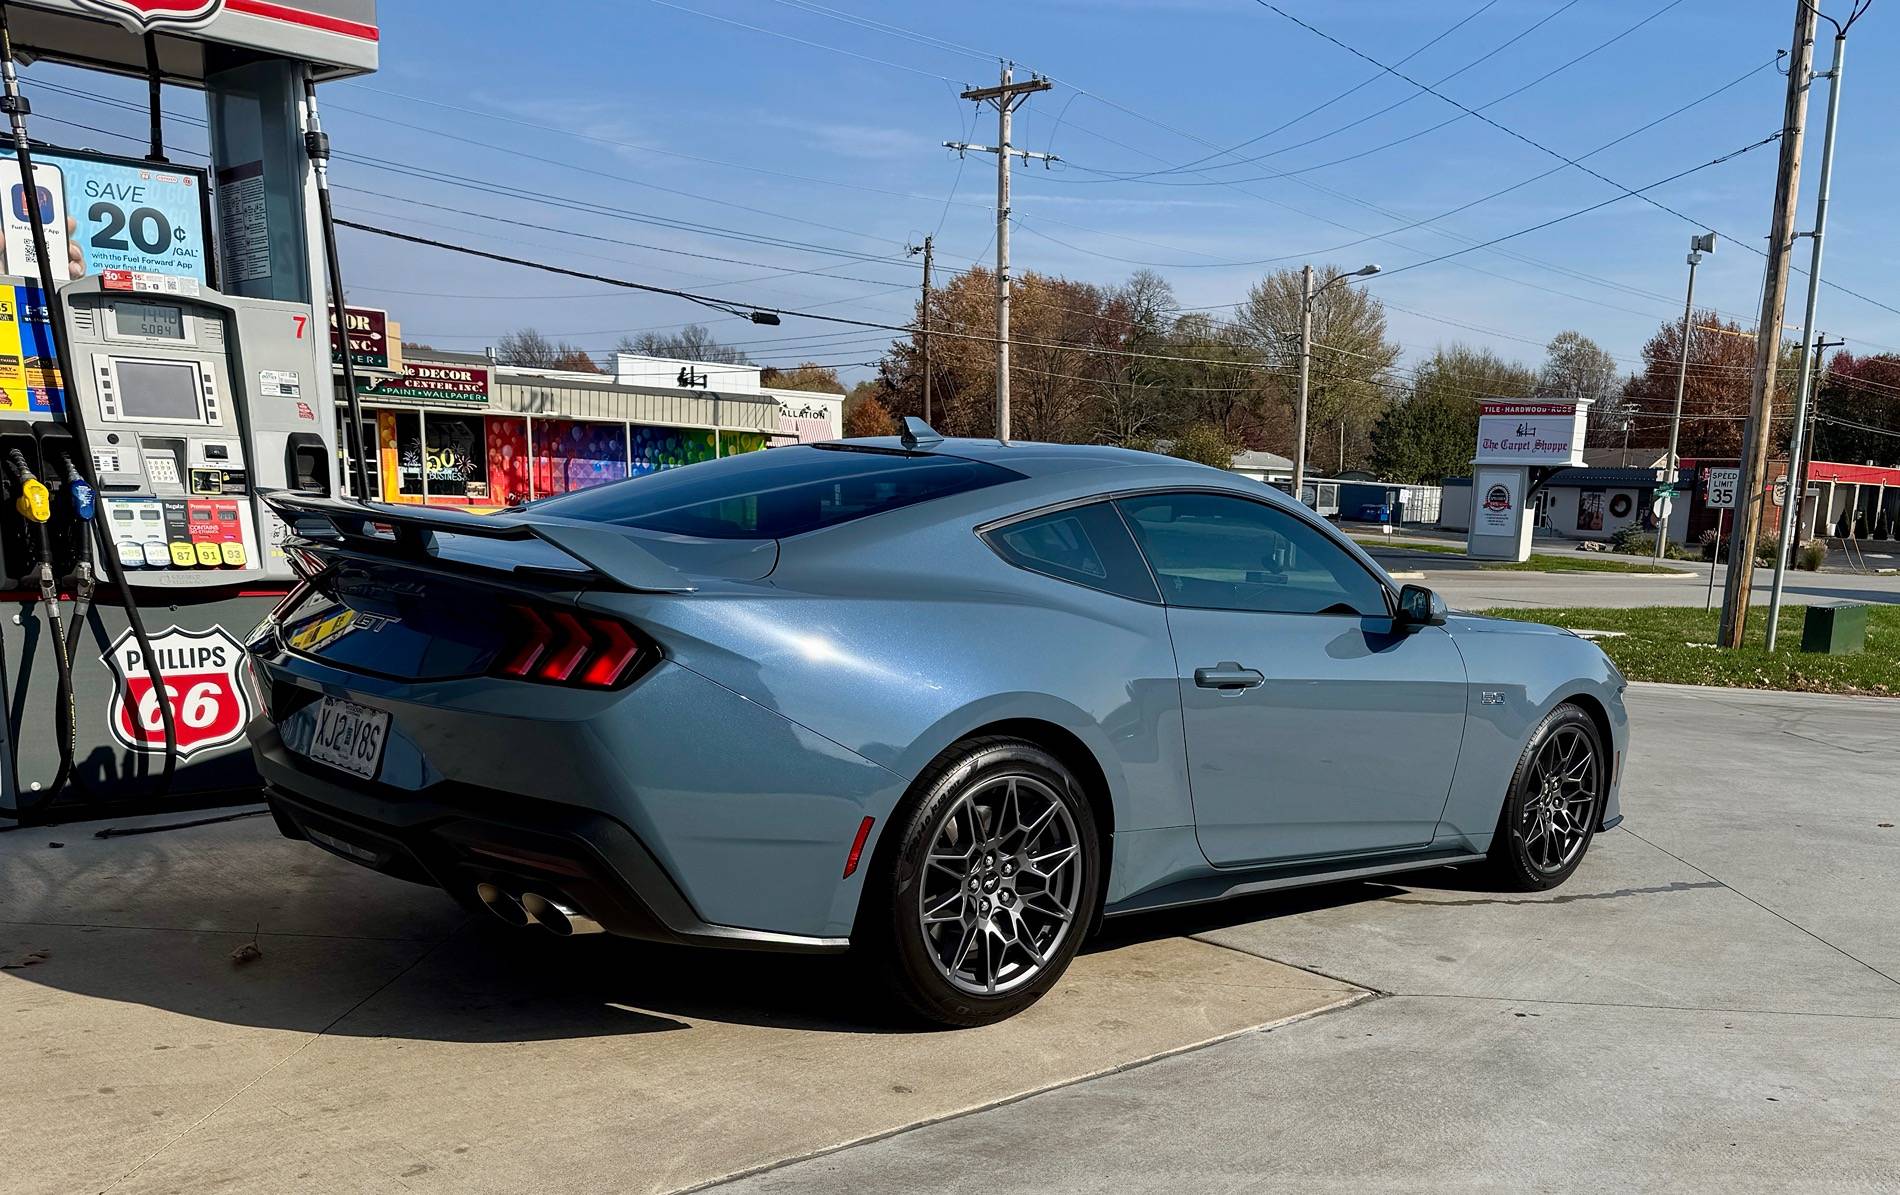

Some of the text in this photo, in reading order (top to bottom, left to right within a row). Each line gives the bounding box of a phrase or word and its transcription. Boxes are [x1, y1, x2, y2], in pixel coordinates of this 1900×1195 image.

[84, 180, 146, 203] SAVE
[92, 252, 108, 261] with
[109, 254, 122, 262] the
[123, 255, 140, 263] Fuel
[176, 260, 193, 269] App
[292, 316, 307, 339] 7
[418, 367, 472, 381] DECOR
[387, 388, 482, 400] PAINT WALLPAPER
[459, 384, 483, 392] INC.
[1482, 438, 1568, 453] The Carpet Shoppe
[426, 447, 455, 473] 50
[1712, 472, 1738, 480] SPEED
[1711, 489, 1733, 504] 35
[176, 551, 190, 561] 87
[202, 551, 217, 560] 91
[227, 549, 241, 559] 93
[353, 611, 402, 633] GT
[138, 682, 223, 731] 66
[315, 708, 348, 751] XJ2
